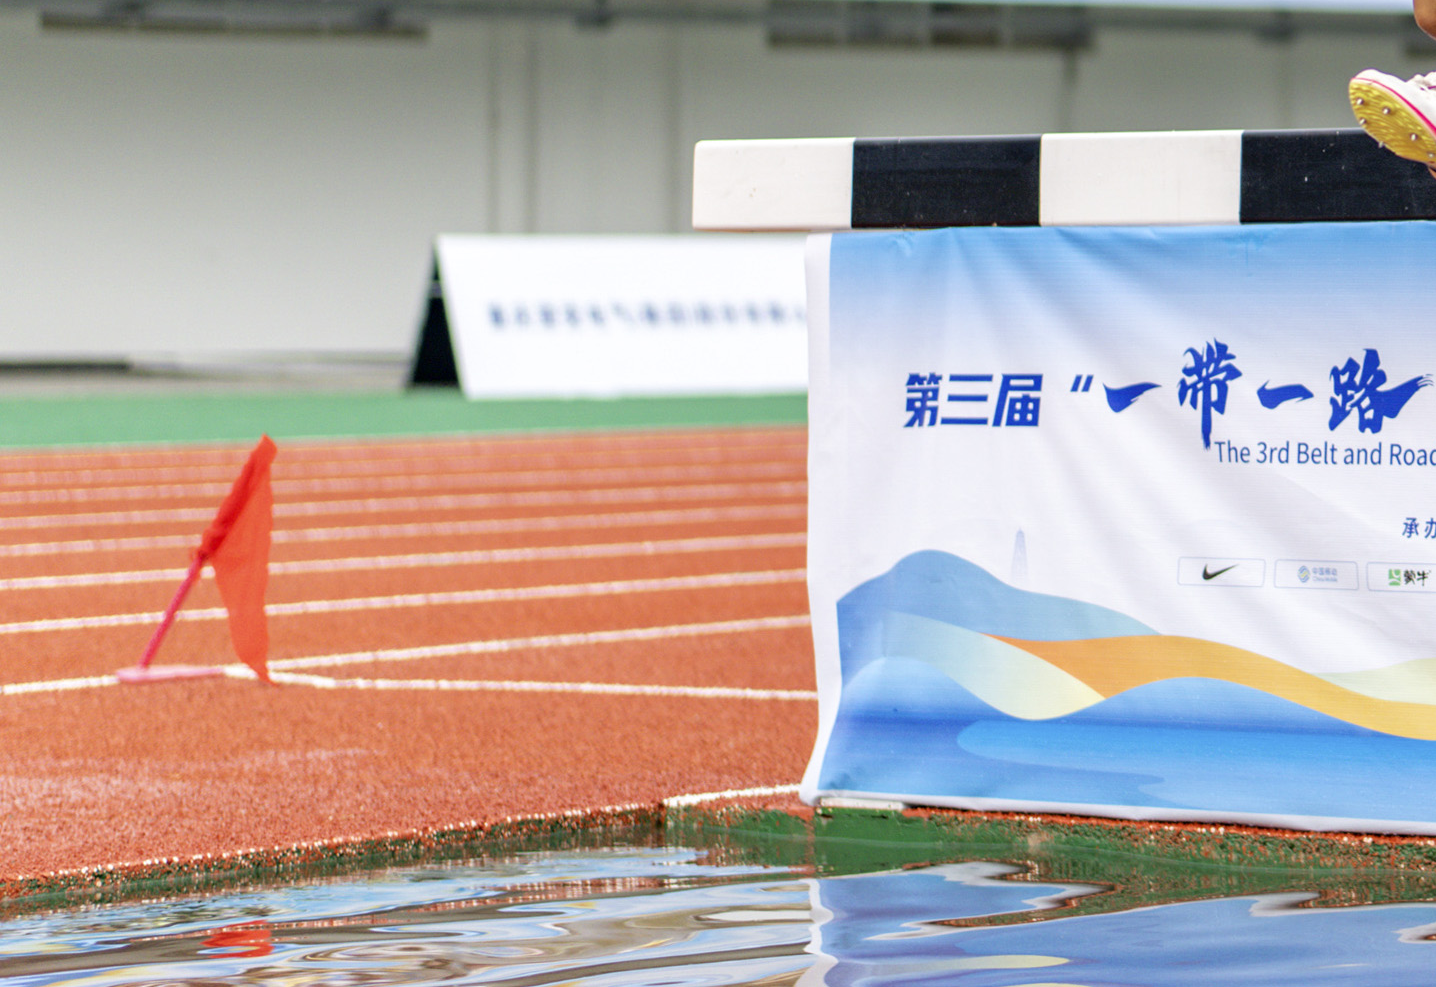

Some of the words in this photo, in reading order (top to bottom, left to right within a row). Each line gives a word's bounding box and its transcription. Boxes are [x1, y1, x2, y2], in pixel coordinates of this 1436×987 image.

[1214, 440, 1251, 464] The
[1256, 441, 1290, 465] 3rd
[1298, 441, 1338, 466] Belt
[1343, 442, 1383, 466] and
[1403, 568, 1429, 587] 蒙牛
